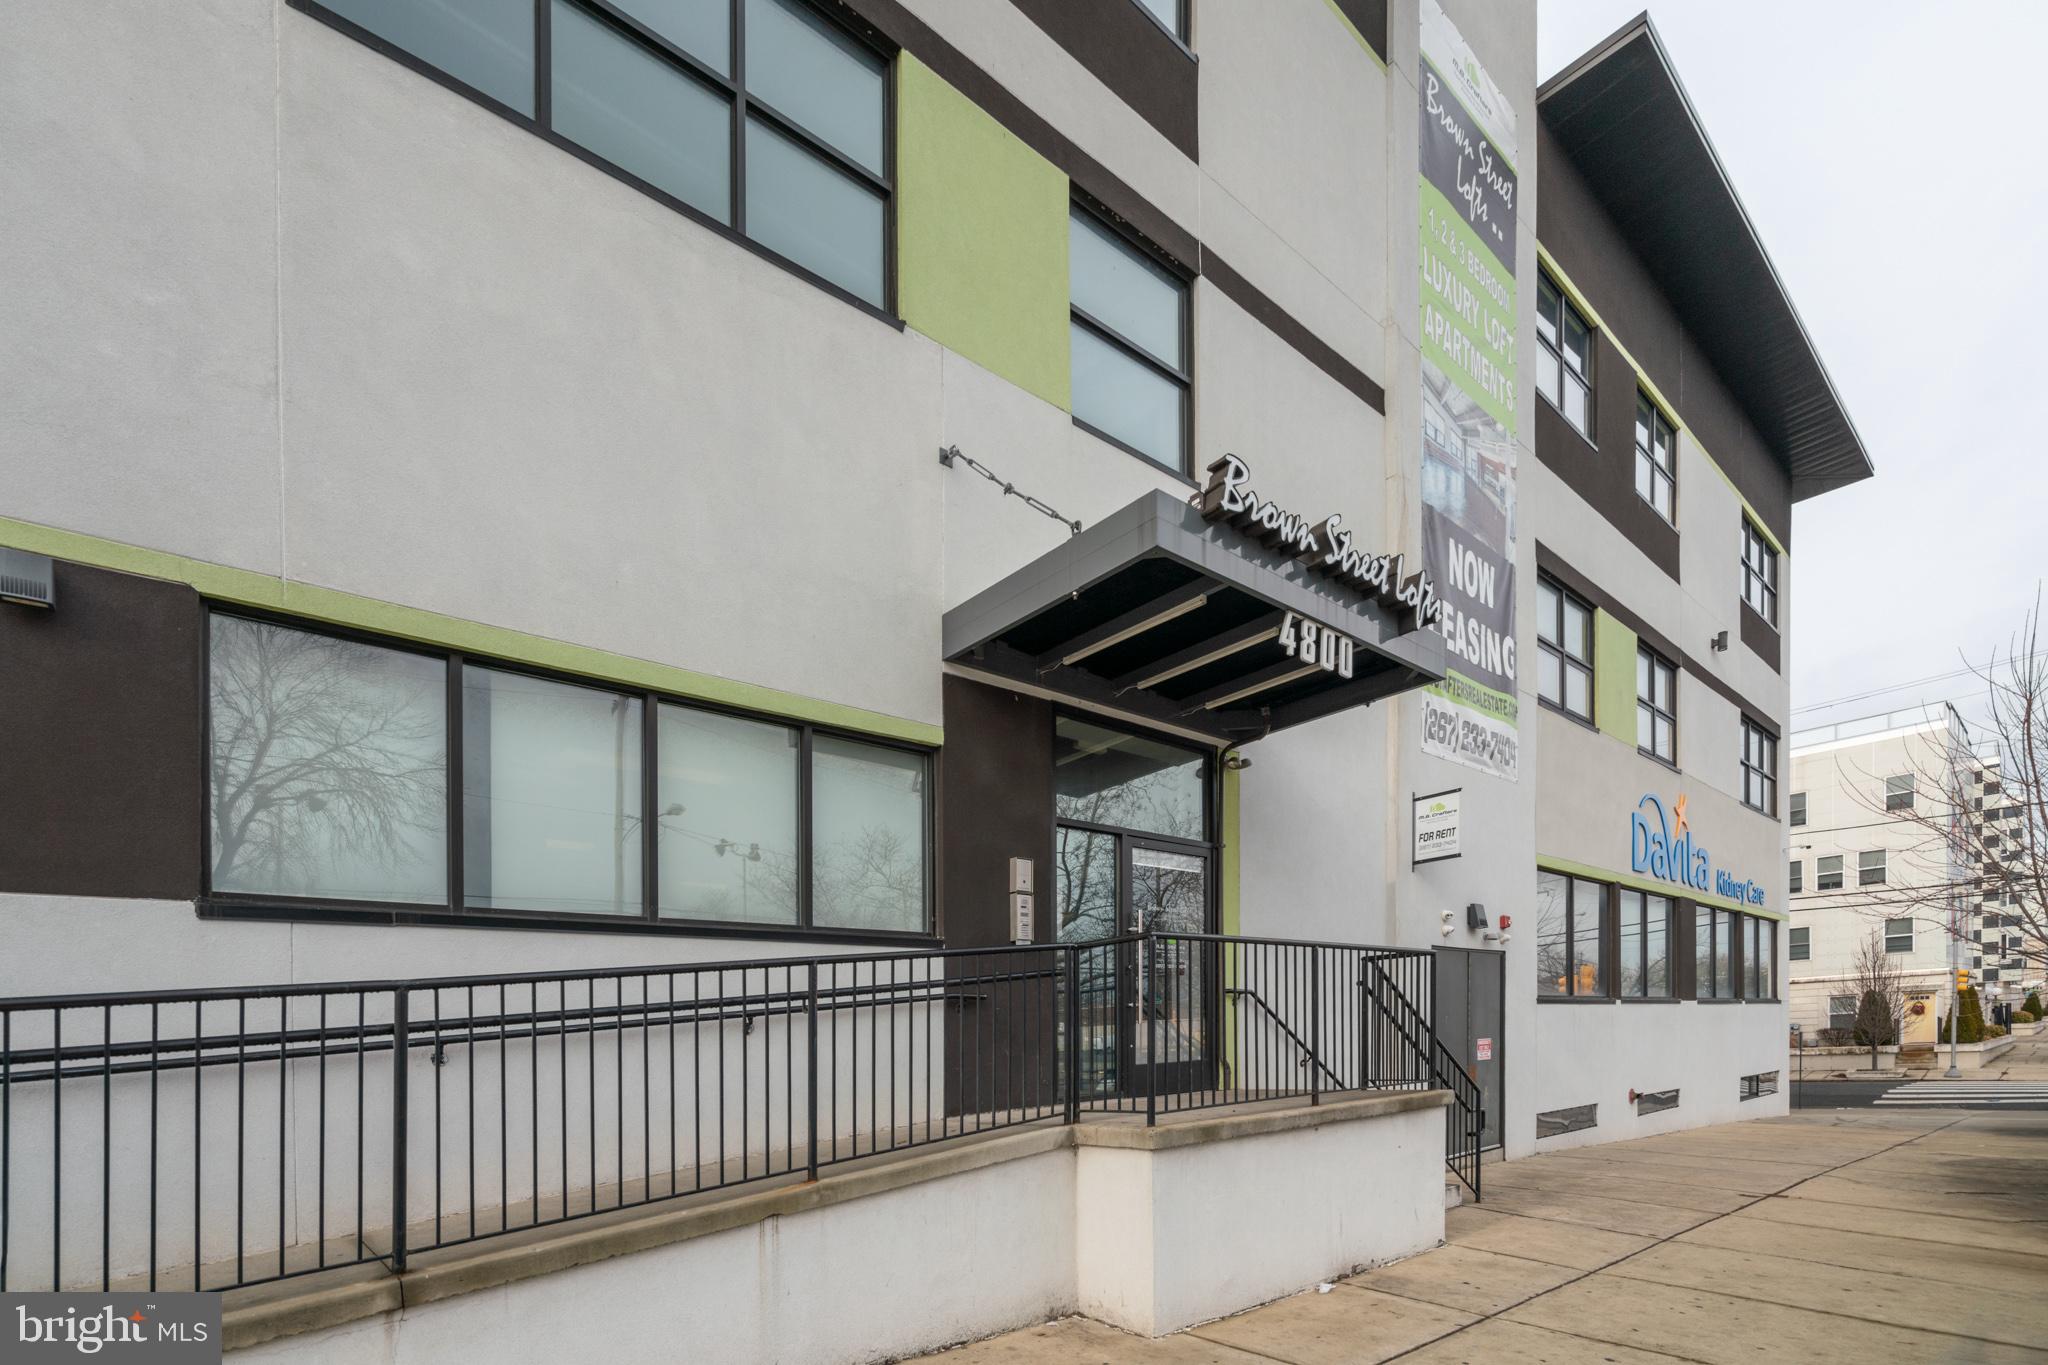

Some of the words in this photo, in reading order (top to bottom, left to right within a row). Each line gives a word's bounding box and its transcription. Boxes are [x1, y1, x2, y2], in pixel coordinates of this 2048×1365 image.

[1427, 73, 1474, 160] Brown
[1479, 141, 1513, 209] Street
[1423, 246, 1480, 329] LUXURY
[1484, 308, 1514, 365] LOFT
[1441, 220, 1447, 244] 2
[1450, 231, 1457, 256] &
[1459, 241, 1465, 264] 3
[1467, 250, 1510, 313] BEDROOM
[1424, 303, 1513, 412] APARTMENTS
[1221, 453, 1318, 552] Brown
[1325, 514, 1391, 594] Street
[1396, 553, 1445, 631] Lofts
[1449, 537, 1495, 609] NOW
[1279, 610, 1353, 679] 4800
[1429, 600, 1515, 680] EASING
[1424, 701, 1459, 753] (267)
[1461, 720, 1517, 768] 233-7404
[1418, 832, 1434, 843] FOR
[1436, 827, 1456, 840] RENT
[1632, 793, 1710, 891] DaVita
[1716, 869, 1746, 906] Kidney
[1747, 879, 1764, 905] Care
